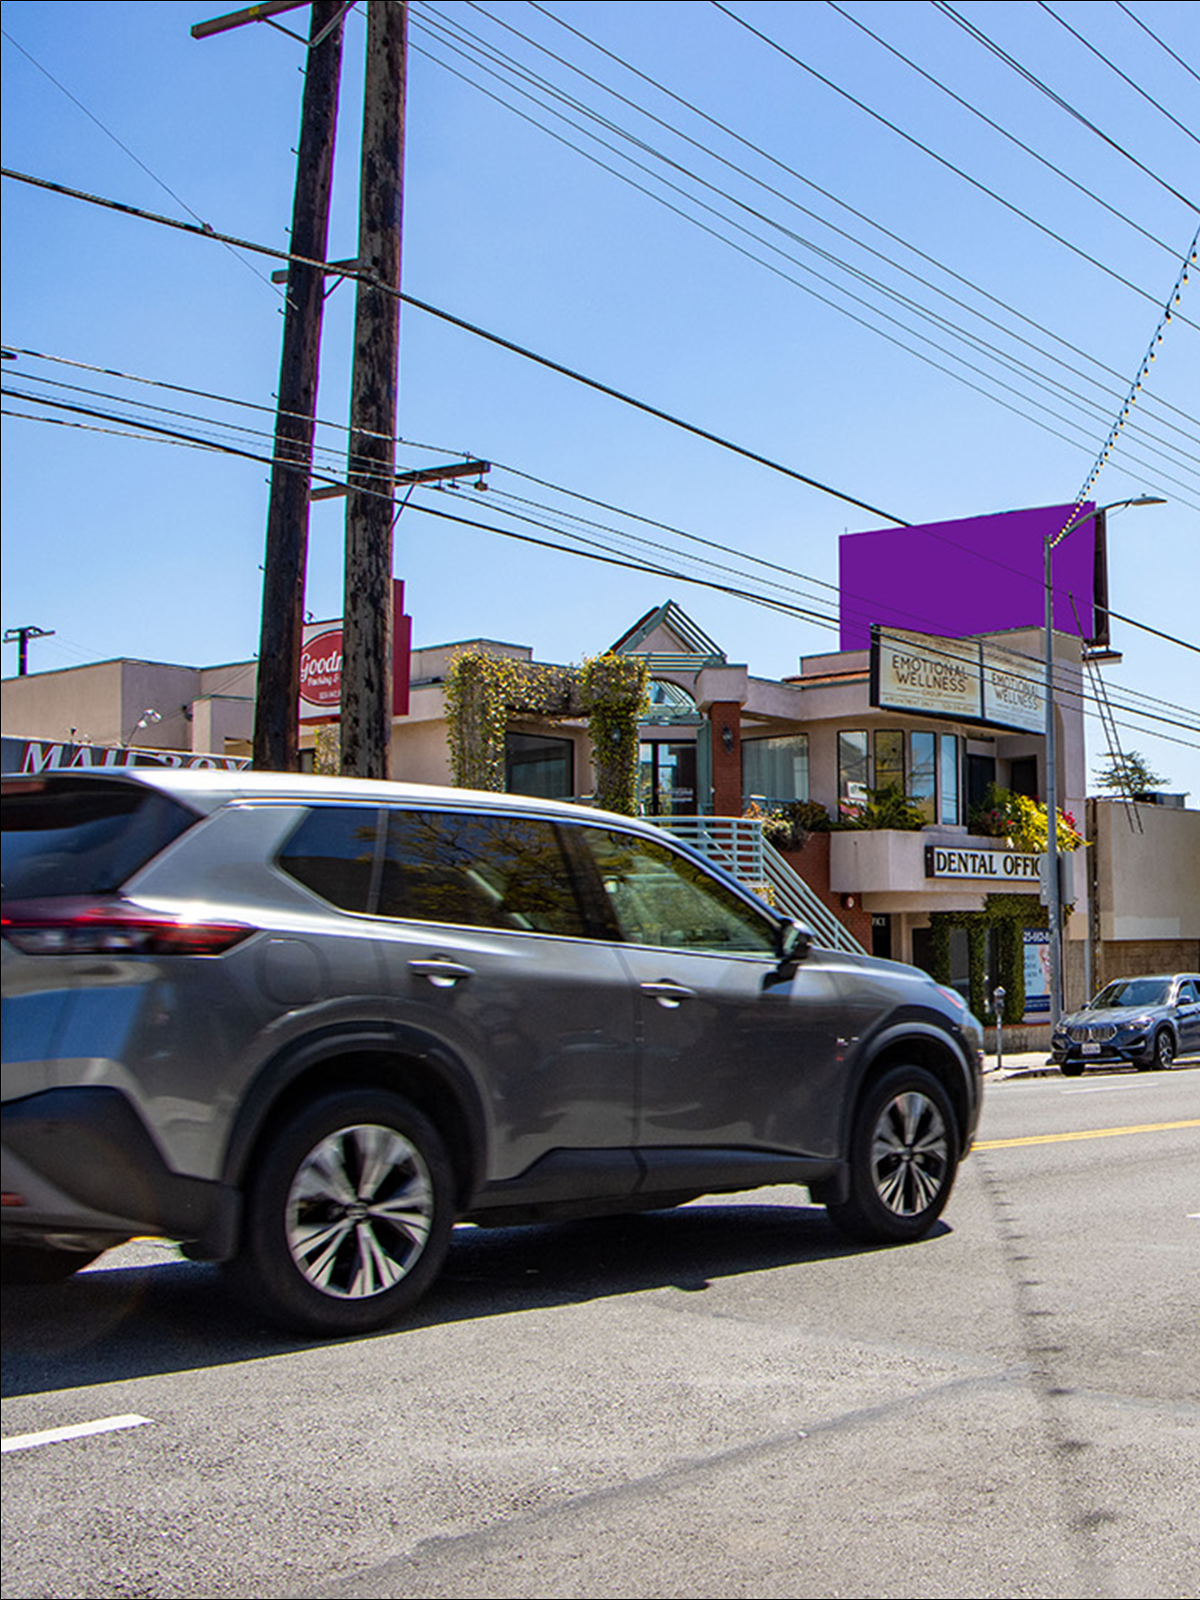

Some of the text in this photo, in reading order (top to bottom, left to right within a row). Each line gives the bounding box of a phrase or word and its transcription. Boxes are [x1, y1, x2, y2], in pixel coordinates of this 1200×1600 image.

[892, 654, 968, 680] EMOTIONAL
[895, 671, 966, 693] WELLNESS
[994, 688, 1039, 710] WELLNESS
[935, 851, 1041, 876] DENTAL OFFIC
